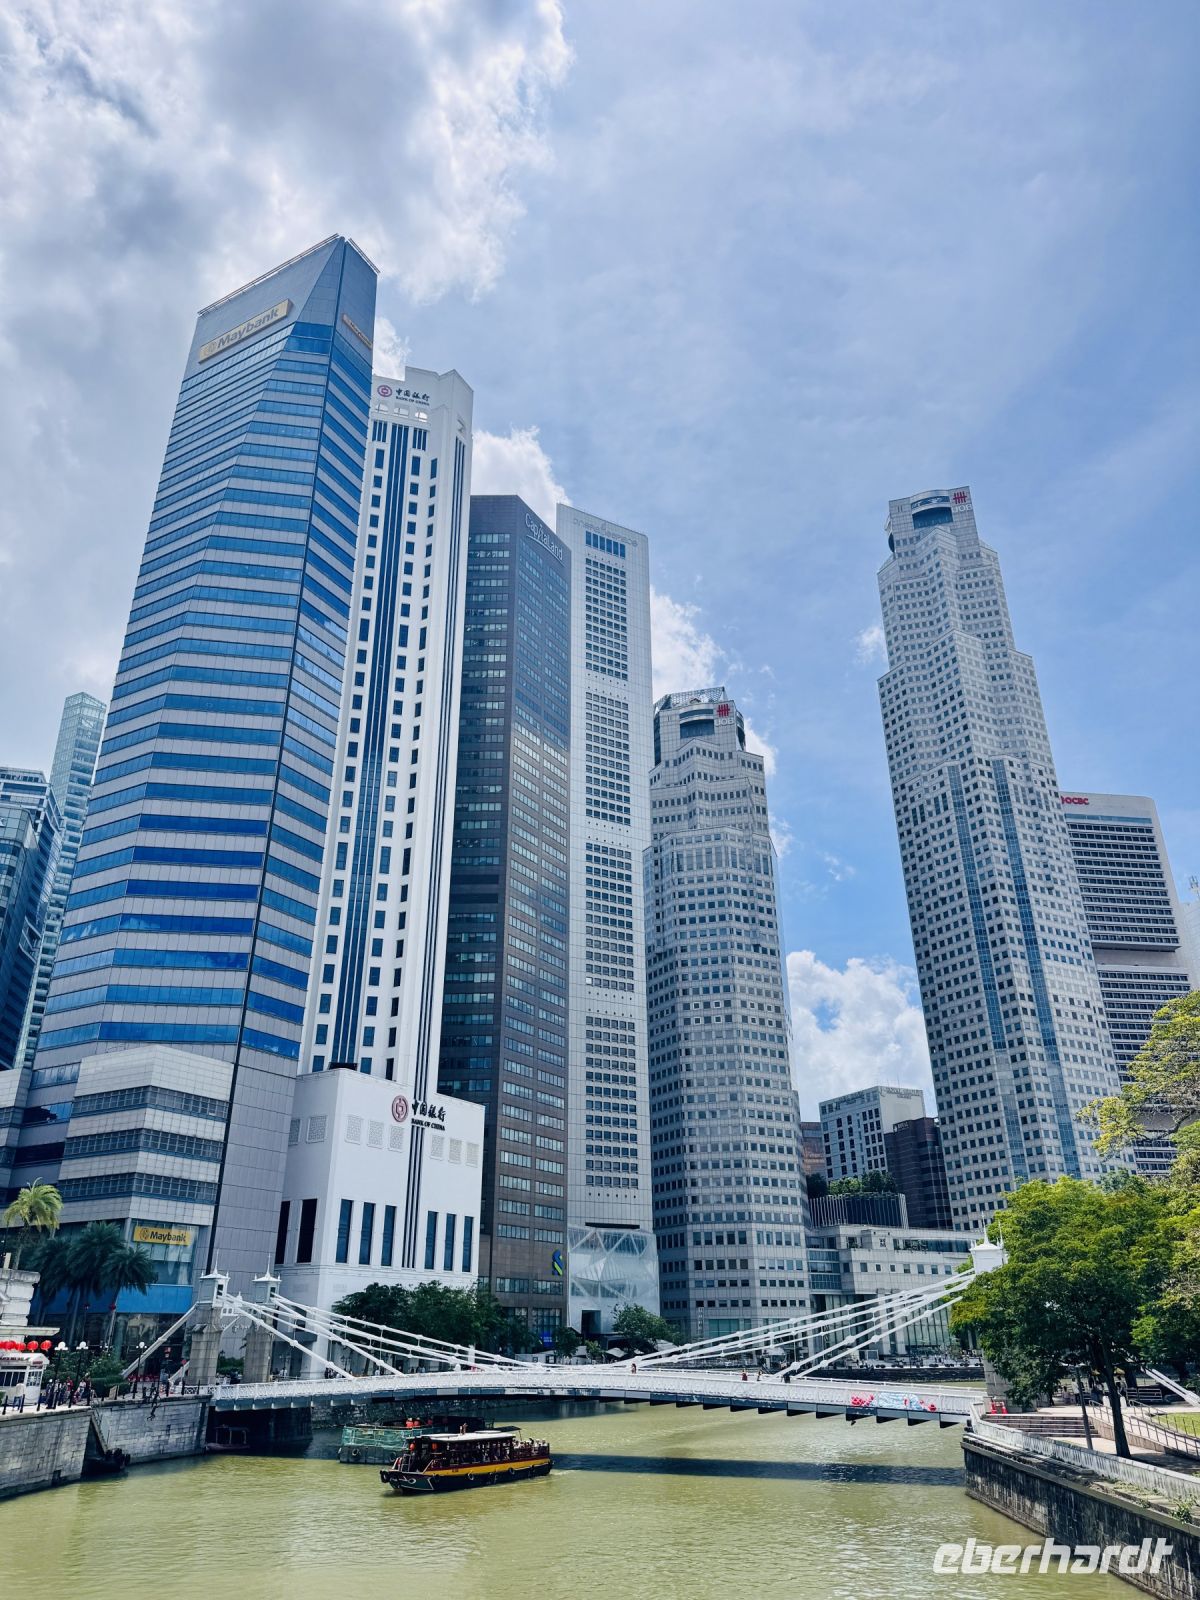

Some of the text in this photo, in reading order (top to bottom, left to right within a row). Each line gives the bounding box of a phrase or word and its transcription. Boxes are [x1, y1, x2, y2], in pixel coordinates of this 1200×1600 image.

[218, 307, 279, 348] Maybank
[951, 503, 973, 513] UOB
[525, 512, 563, 560] CapitaLand
[715, 718, 734, 727] UOB
[1065, 796, 1090, 805] OCBC
[411, 1099, 446, 1123] 中国银行
[411, 1118, 424, 1126] BANK
[431, 1122, 446, 1131] CHINA
[150, 1231, 186, 1245] Maybank
